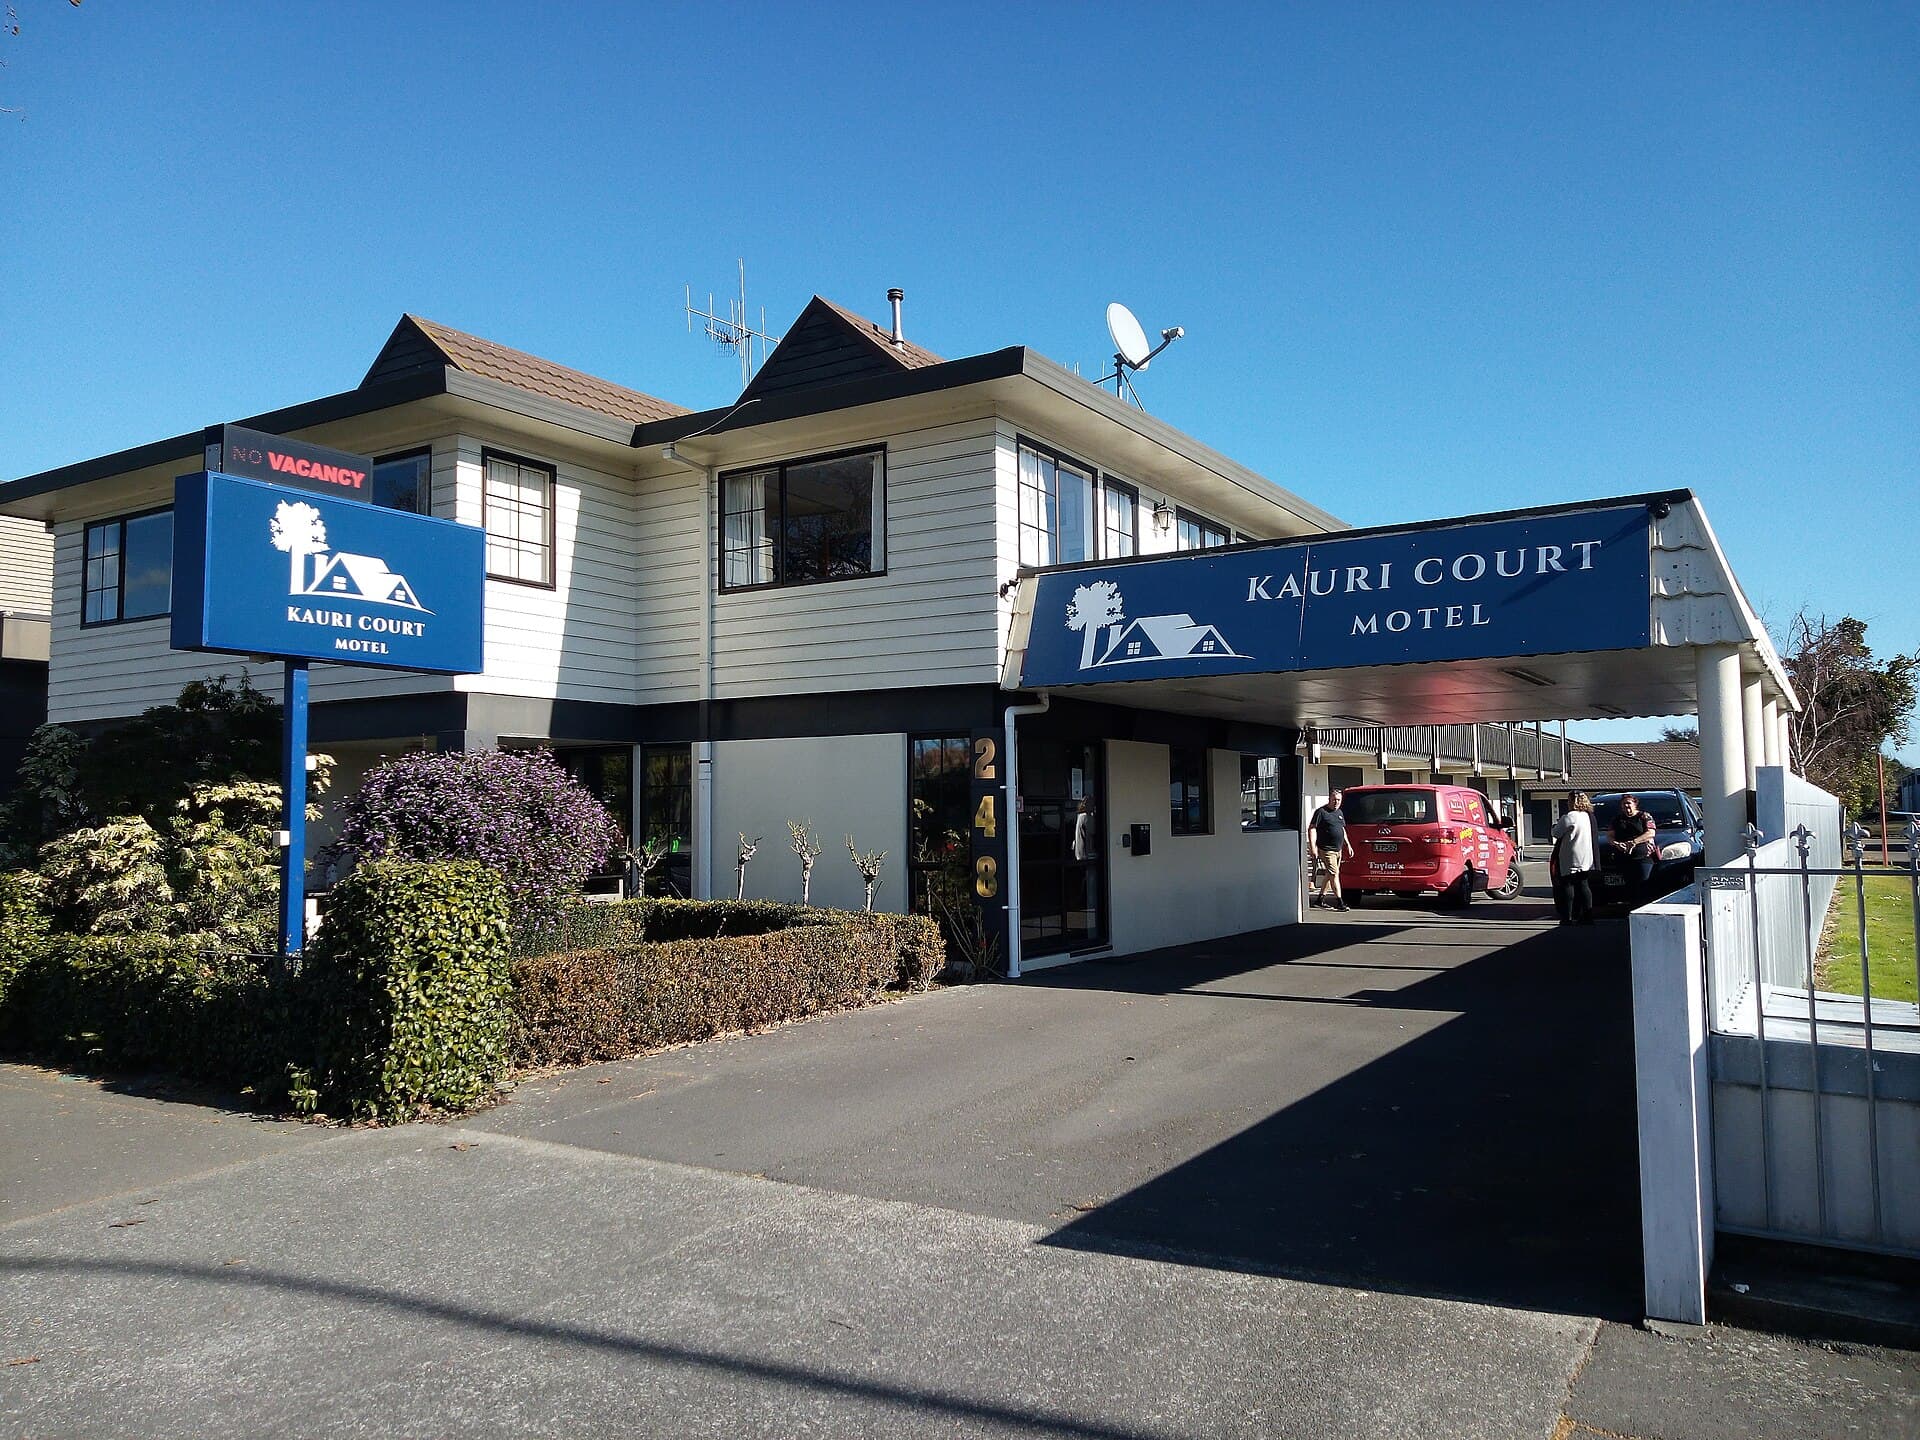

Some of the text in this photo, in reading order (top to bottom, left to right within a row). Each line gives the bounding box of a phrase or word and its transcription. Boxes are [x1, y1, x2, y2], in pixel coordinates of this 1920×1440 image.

[232, 446, 365, 488] NO VACANCY
[1246, 540, 1602, 602] KAURI COURT
[287, 606, 425, 637] KAURI COURT
[1351, 603, 1490, 635] MOTEL
[335, 637, 389, 655] MOTEL
[1367, 861, 1405, 871] Taylor's
